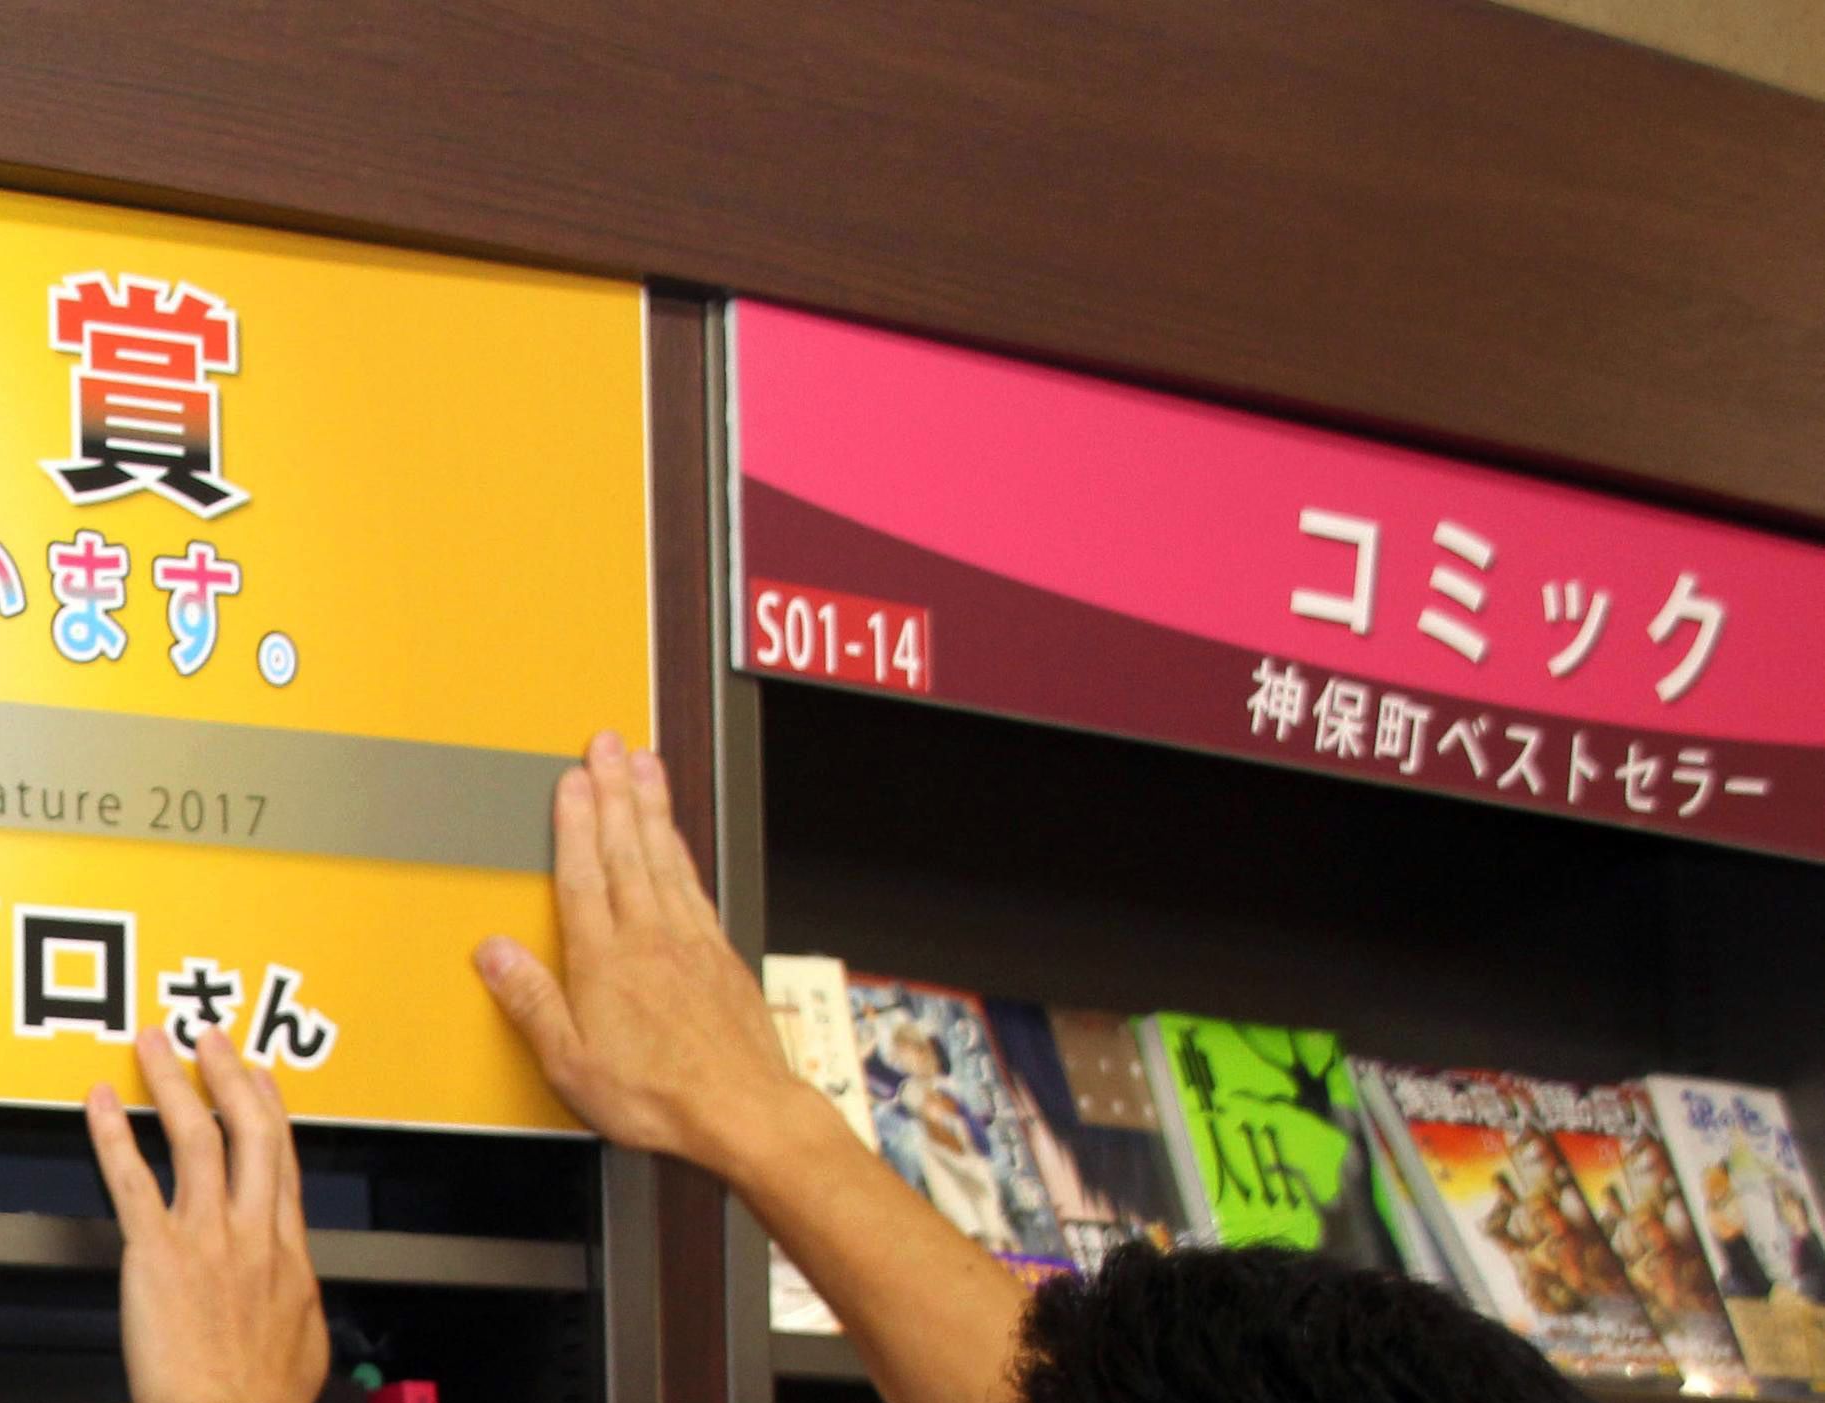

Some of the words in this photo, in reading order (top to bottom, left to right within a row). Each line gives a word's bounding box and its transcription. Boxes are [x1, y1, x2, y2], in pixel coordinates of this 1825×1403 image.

[755, 592, 924, 688] S01-14
[1289, 506, 1728, 704] コミック
[1246, 657, 1772, 819] 神保町ベストセラー
[150, 785, 269, 838] 2017
